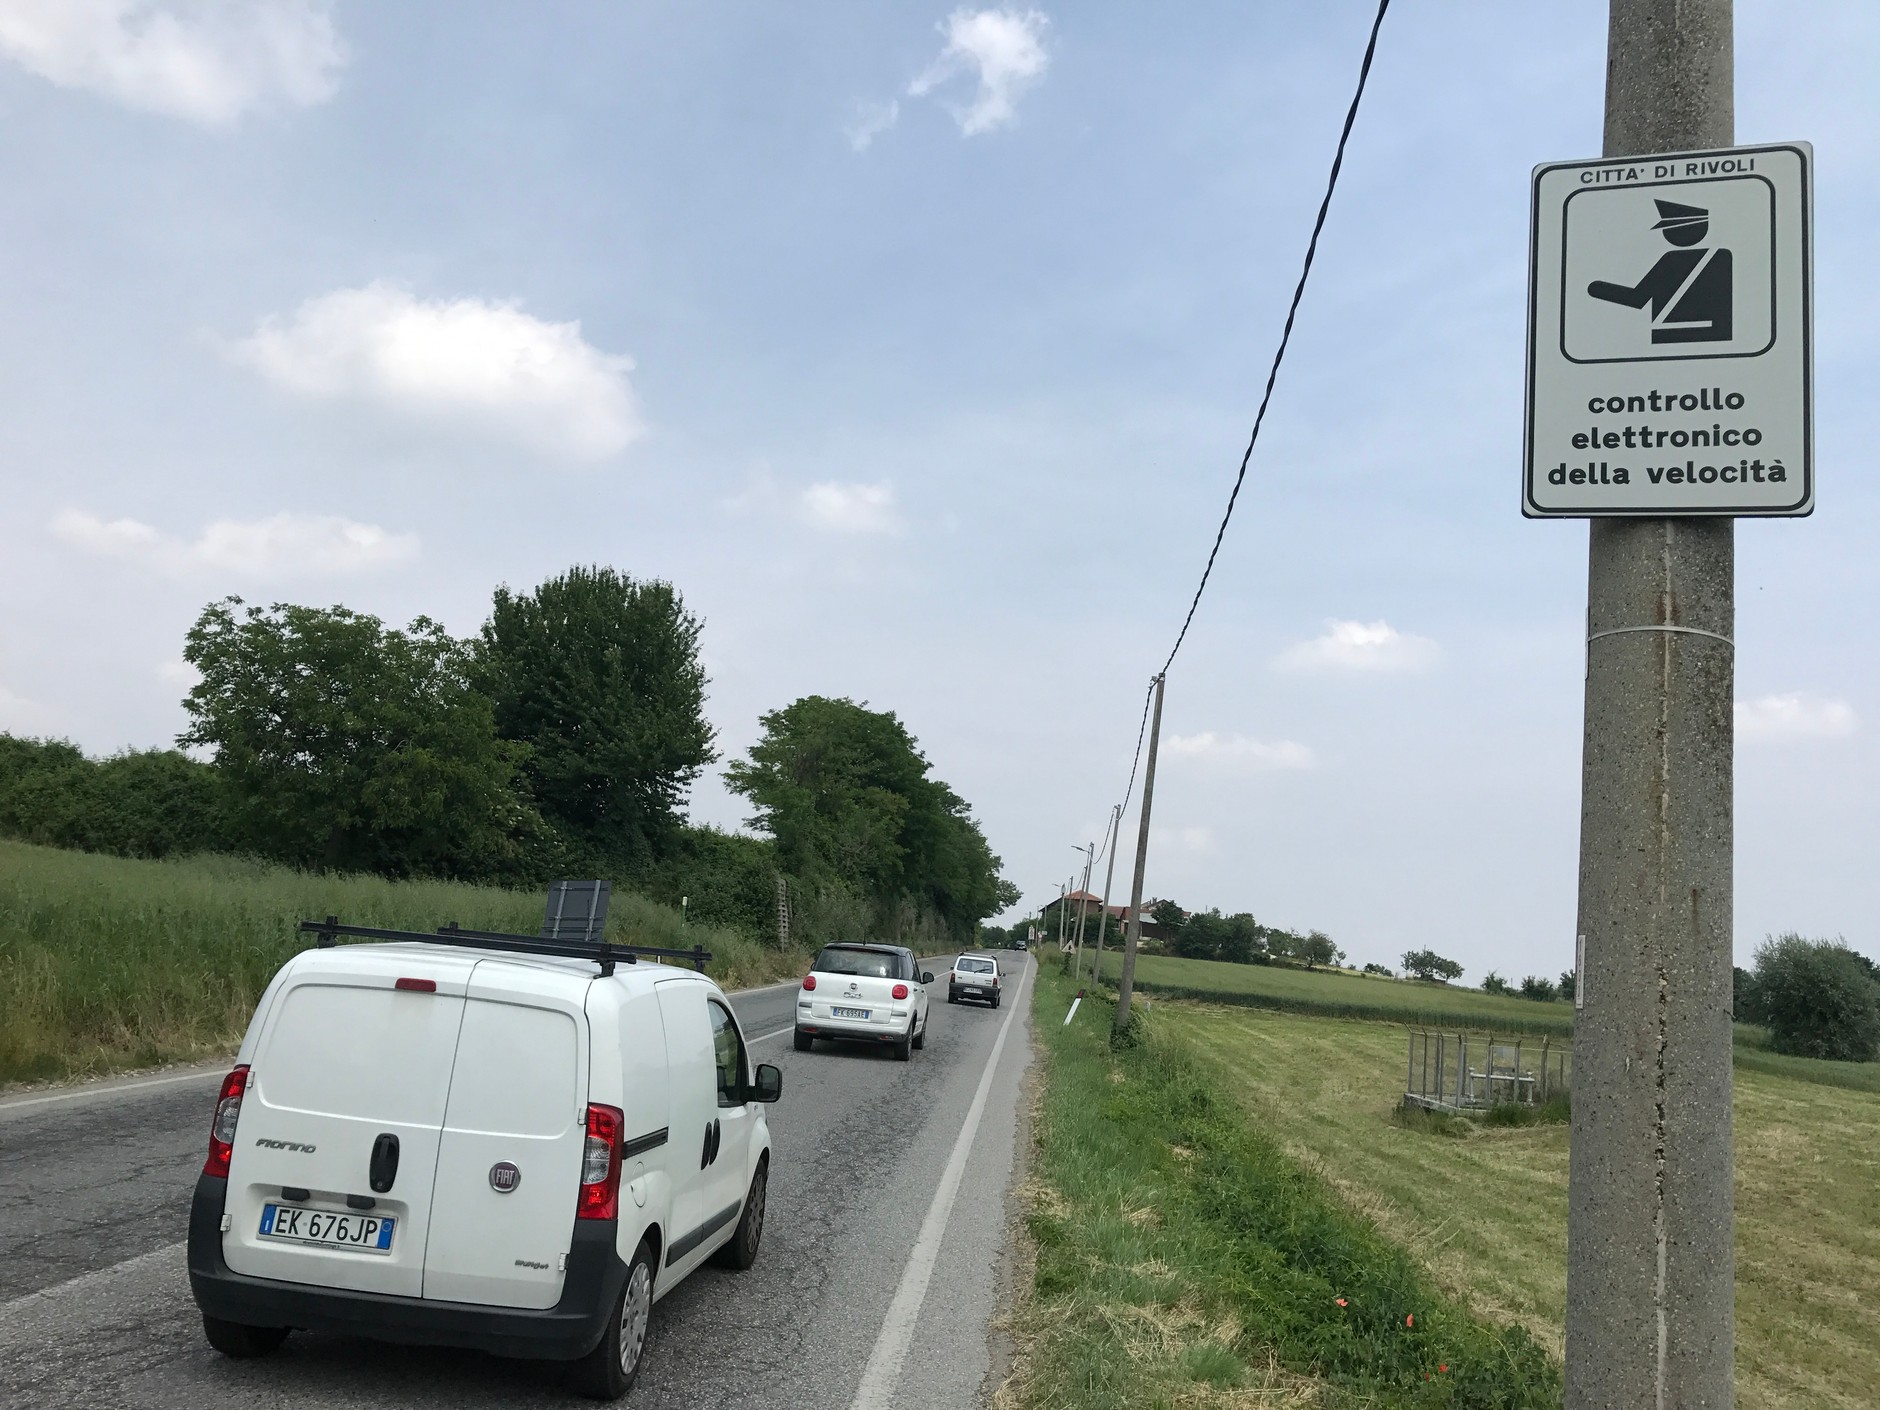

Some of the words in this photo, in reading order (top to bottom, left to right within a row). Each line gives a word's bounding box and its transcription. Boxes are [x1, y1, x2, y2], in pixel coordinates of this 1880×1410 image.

[1580, 167, 1644, 184] CITTA'
[1654, 165, 1675, 178] DI
[1685, 158, 1755, 177] RIVOLI
[1588, 388, 1744, 413] controllo
[1571, 424, 1762, 449] elettronico
[1548, 462, 1630, 485] della
[1646, 459, 1787, 484] velocità
[496, 1169, 515, 1185] FIAT
[275, 1209, 303, 1235] EK
[309, 1213, 378, 1243] 676JP
